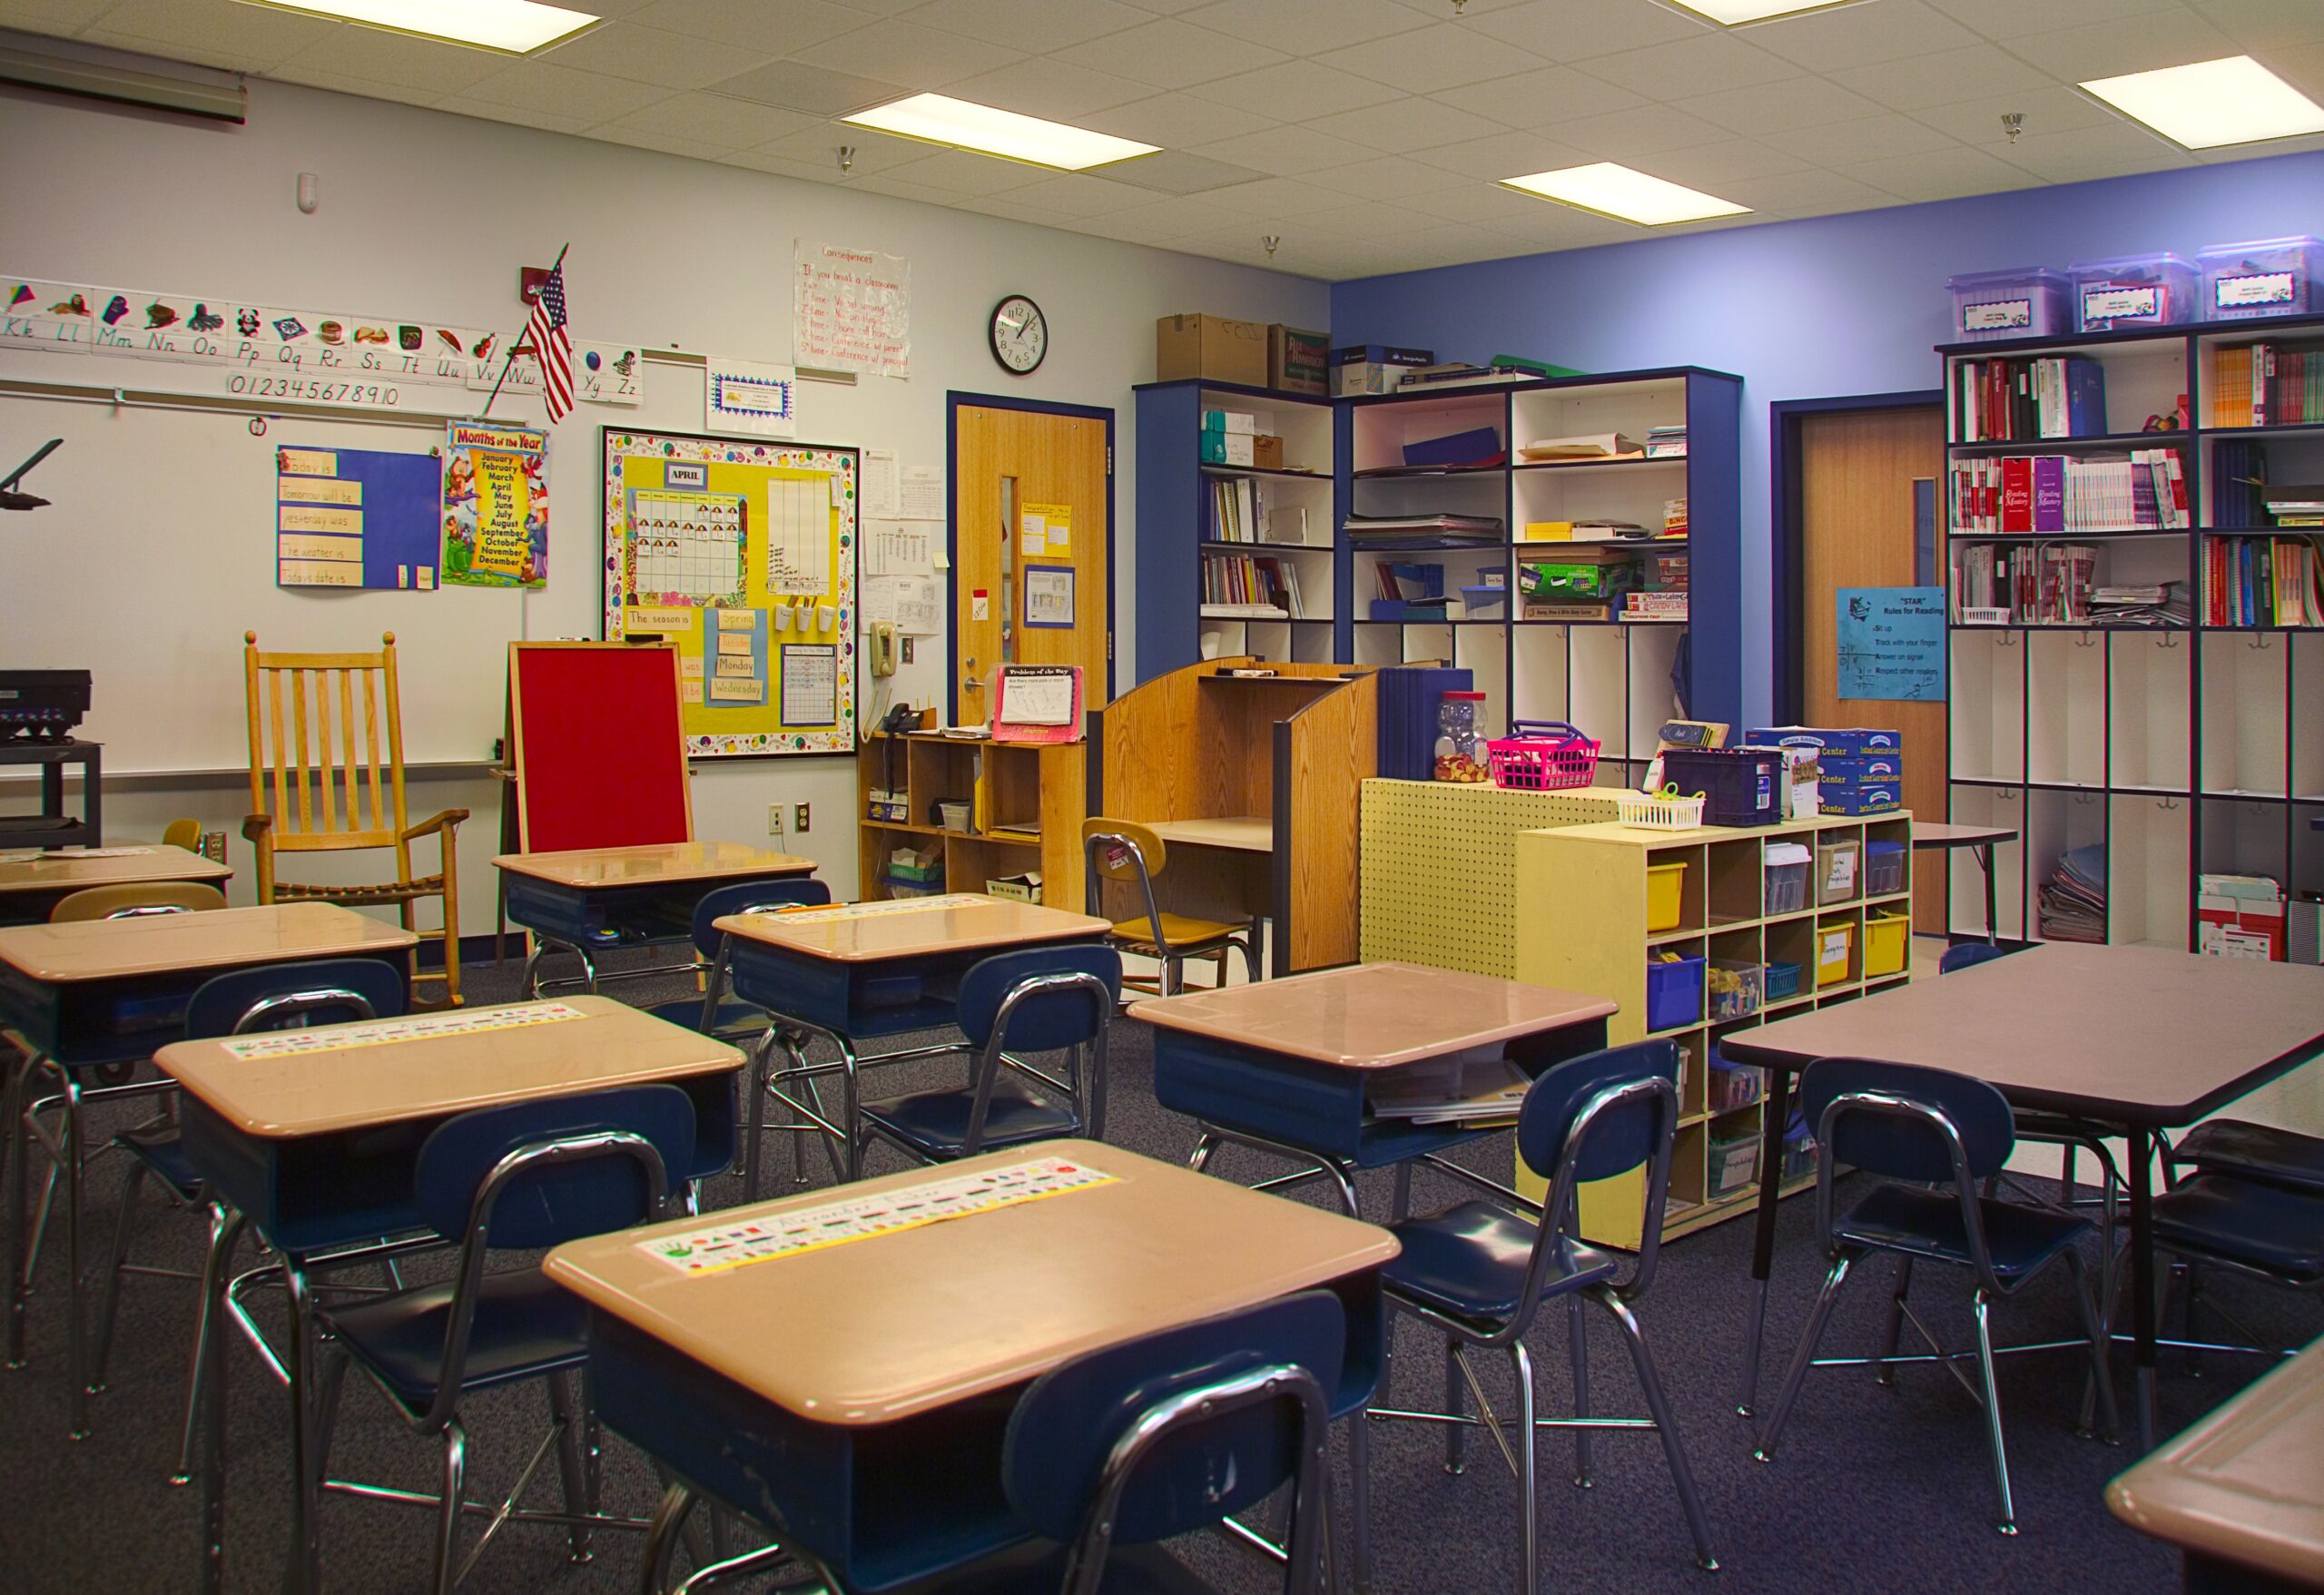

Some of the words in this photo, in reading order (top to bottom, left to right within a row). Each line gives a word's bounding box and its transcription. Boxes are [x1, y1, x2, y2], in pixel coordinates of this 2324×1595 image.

[822, 246, 872, 263] Consequences
[803, 264, 812, 276] If
[817, 271, 830, 281] you
[833, 271, 852, 282] break
[865, 275, 899, 290] classroom
[1009, 310, 1014, 319] 11
[1016, 308, 1024, 316] 12
[999, 329, 1005, 337] 9
[1033, 334, 1039, 343] 3
[1001, 340, 1007, 350] 8
[1016, 355, 1021, 364] 6
[1024, 352, 1029, 361] 5
[458, 428, 496, 448] Months
[497, 437, 505, 447] of
[505, 437, 518, 448] the
[519, 434, 541, 450] Year
[481, 453, 514, 466] January
[287, 458, 319, 473] Today
[322, 460, 331, 474] is
[482, 462, 518, 474] February
[488, 472, 515, 482] March
[671, 470, 700, 481] APRIL
[491, 482, 512, 493] April
[281, 485, 320, 501] Tomorrow
[322, 489, 339, 502] will
[342, 493, 352, 503] be
[494, 492, 512, 503] May
[2005, 489, 2028, 498] Reading
[2038, 489, 2062, 498] Reading
[494, 500, 514, 510] June
[2005, 497, 2028, 507] Mastery
[2037, 497, 2062, 507] Mastery
[496, 510, 513, 521] July
[330, 517, 349, 527] was
[490, 518, 518, 530] August
[1669, 516, 1687, 526] BING
[481, 527, 525, 539] September
[486, 537, 519, 547] October
[281, 543, 298, 556] The
[301, 547, 333, 558] weather
[336, 548, 344, 558] is
[481, 546, 523, 557] November
[479, 556, 519, 566] December
[315, 573, 333, 584] date
[336, 574, 346, 584] is
[1915, 607, 1944, 615] Reading
[629, 612, 648, 624] The
[653, 615, 680, 625] season
[682, 615, 689, 625] is
[724, 614, 754, 629] Spring
[721, 635, 751, 650] Tuesday
[1920, 639, 1937, 647] finger
[1906, 654, 1924, 662] signal
[684, 663, 701, 672] was
[719, 660, 753, 675] Monday
[1876, 667, 1898, 675] Respect
[691, 685, 701, 696] be
[715, 682, 761, 697] Wednesday
[1821, 775, 1846, 783] Center
[1821, 804, 1846, 812] Center
